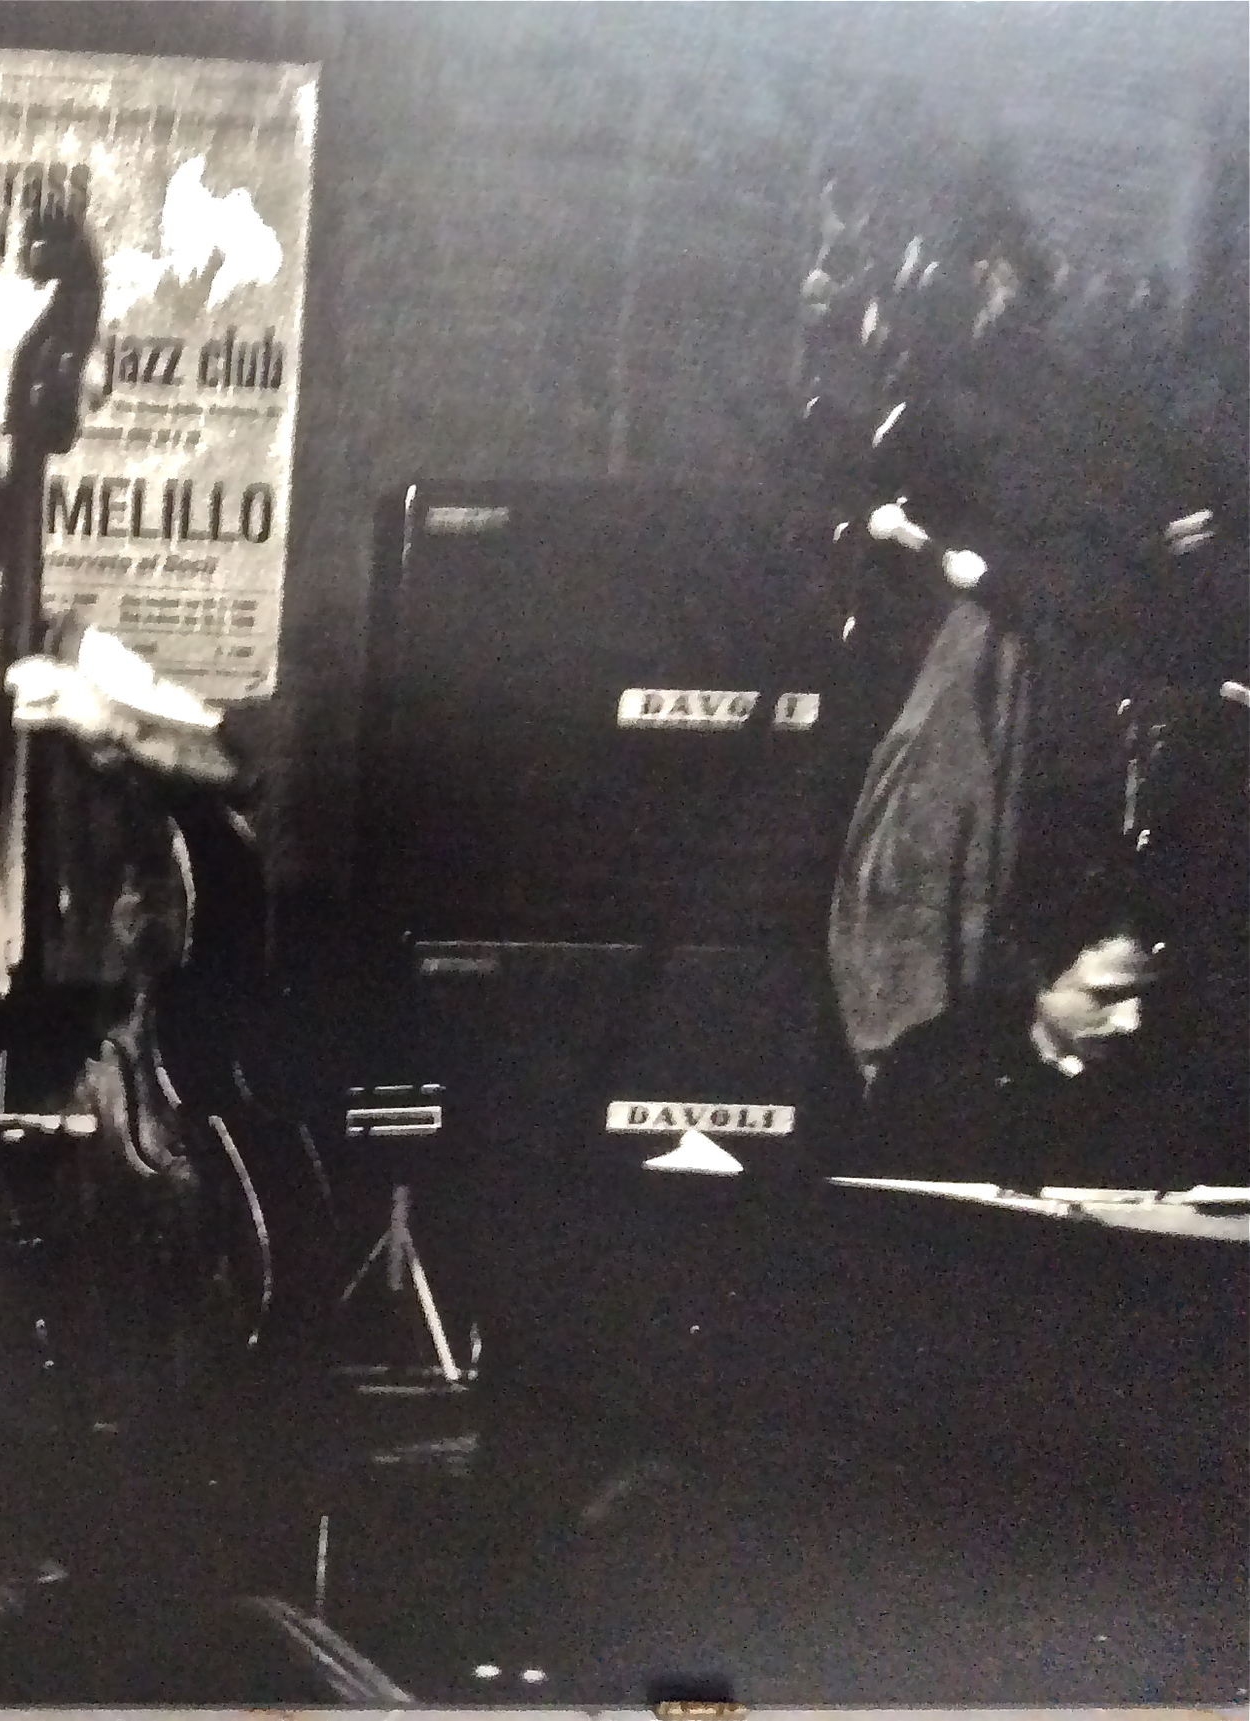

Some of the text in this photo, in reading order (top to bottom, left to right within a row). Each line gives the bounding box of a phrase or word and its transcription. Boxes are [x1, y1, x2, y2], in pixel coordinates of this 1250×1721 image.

[92, 319, 284, 400] jazz club
[47, 474, 273, 543] MELILLO
[641, 693, 798, 717] DAVOI
[628, 1105, 777, 1129] DAVOLI
